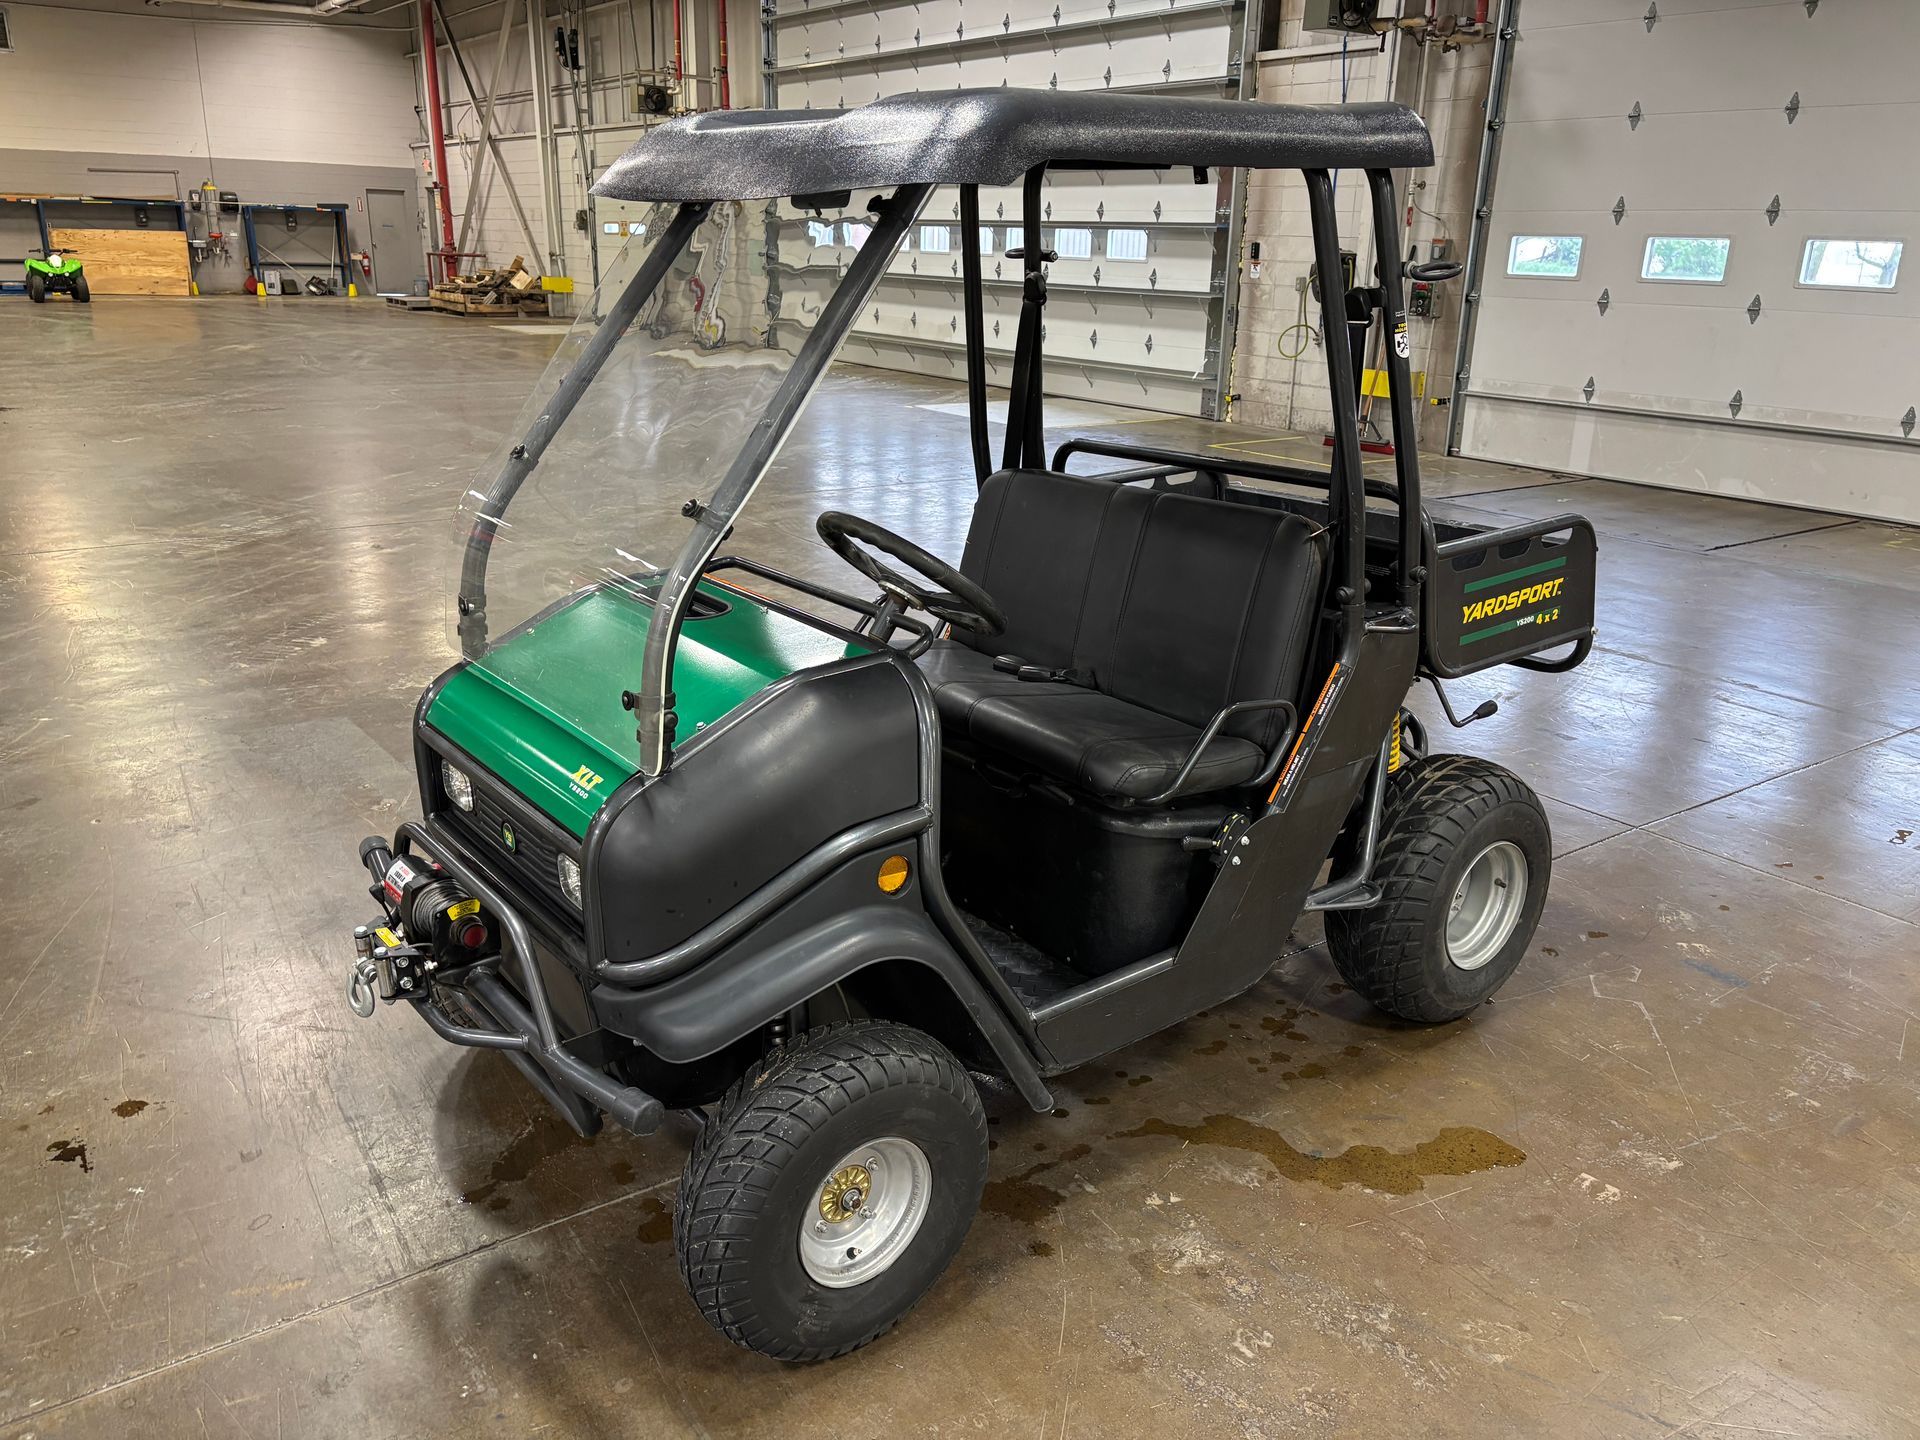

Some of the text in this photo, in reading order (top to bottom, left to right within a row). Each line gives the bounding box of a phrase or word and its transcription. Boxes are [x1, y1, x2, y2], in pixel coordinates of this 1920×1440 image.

[1462, 578, 1564, 624] YARDSPORT
[1516, 615, 1535, 626] YS200
[1536, 613, 1543, 625] 4
[1552, 608, 1559, 621] 2
[570, 764, 604, 791] XLT
